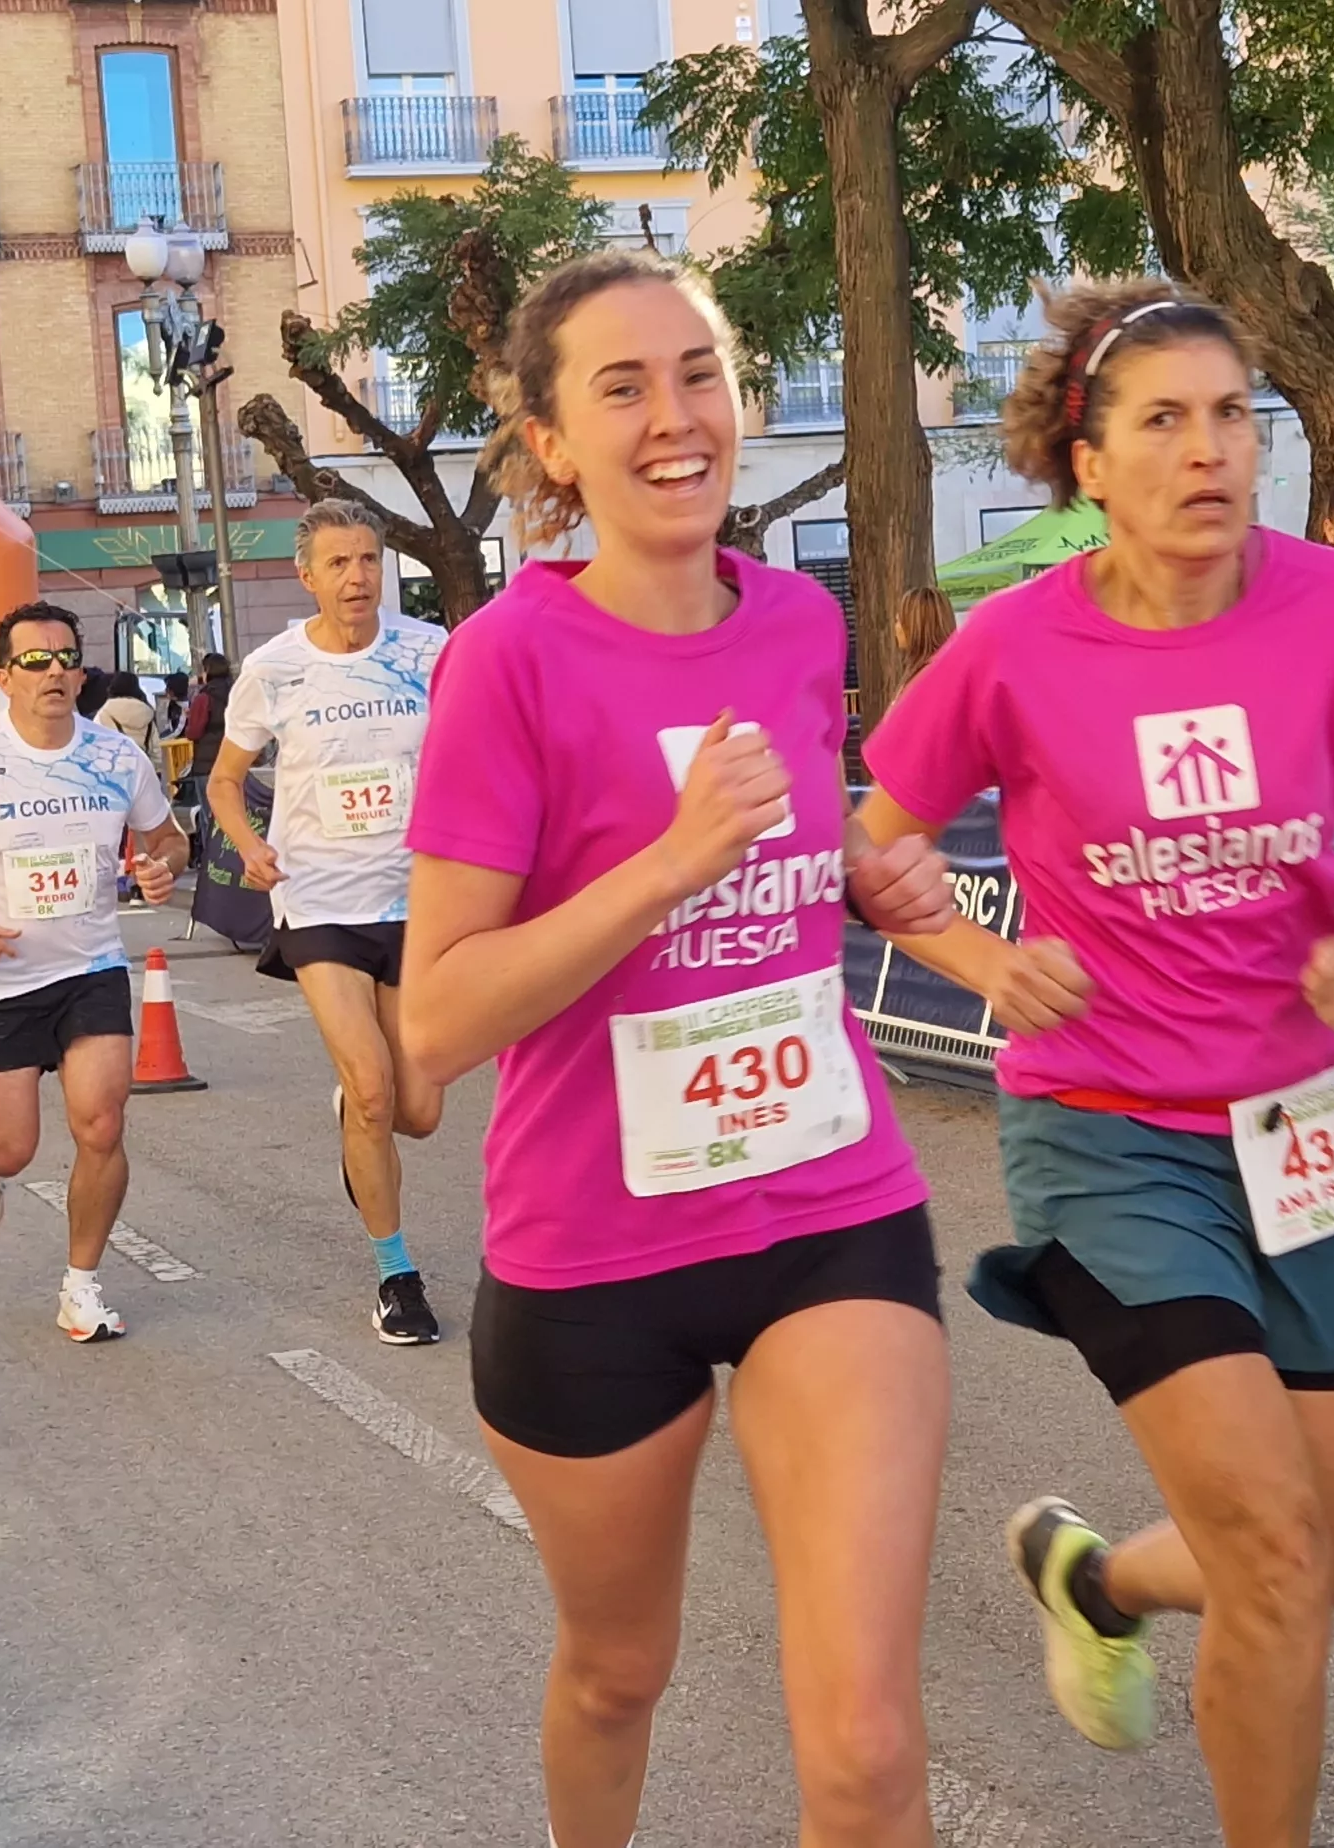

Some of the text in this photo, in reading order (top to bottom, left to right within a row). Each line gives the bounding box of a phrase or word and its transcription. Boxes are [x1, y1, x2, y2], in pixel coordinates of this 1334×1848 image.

[325, 700, 418, 722] COGITIAR
[19, 796, 110, 817] COGITIAR
[340, 784, 394, 810] 312
[346, 808, 392, 821] MIGUEL
[1082, 812, 1325, 888] salesianos
[28, 867, 79, 892] 314
[36, 892, 75, 904] PEDRO
[1139, 868, 1288, 921] HUESCA
[682, 1035, 811, 1107] 430
[706, 1136, 751, 1178] 8K
